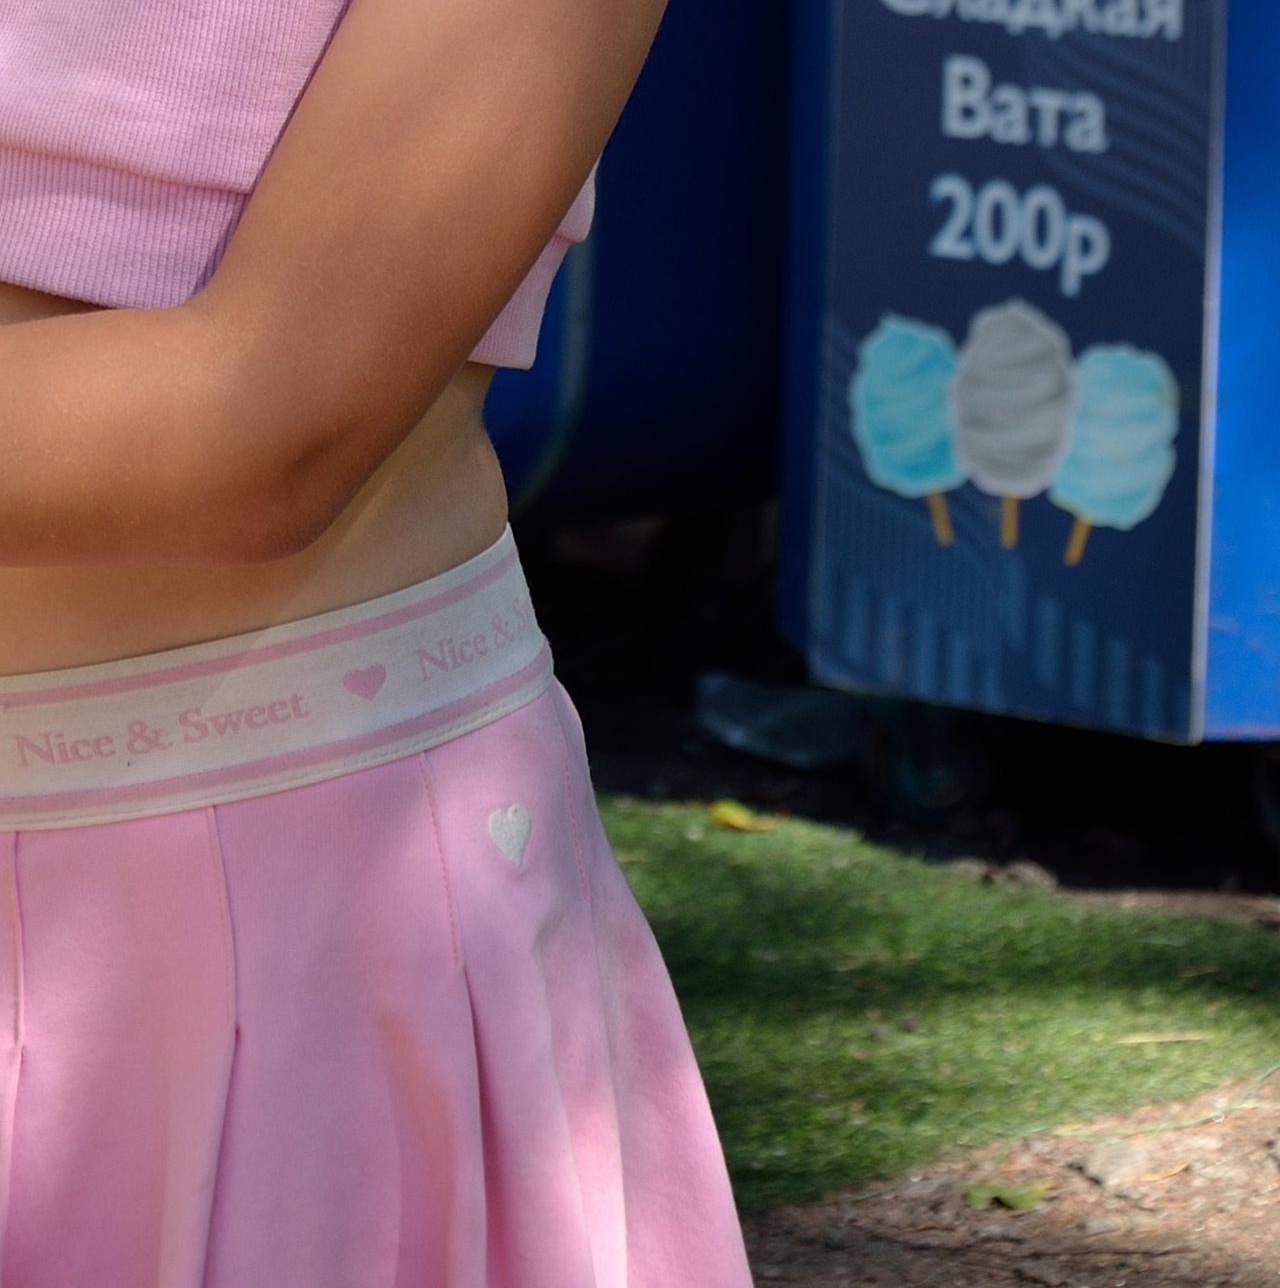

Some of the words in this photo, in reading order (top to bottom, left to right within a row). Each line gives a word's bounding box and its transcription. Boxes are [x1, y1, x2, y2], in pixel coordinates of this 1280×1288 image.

[941, 53, 1110, 154] Вата
[930, 173, 1111, 298] 200р
[414, 634, 489, 684] Nice
[13, 732, 117, 769] Nice
[126, 719, 175, 757] &
[178, 692, 310, 746] Sweet
